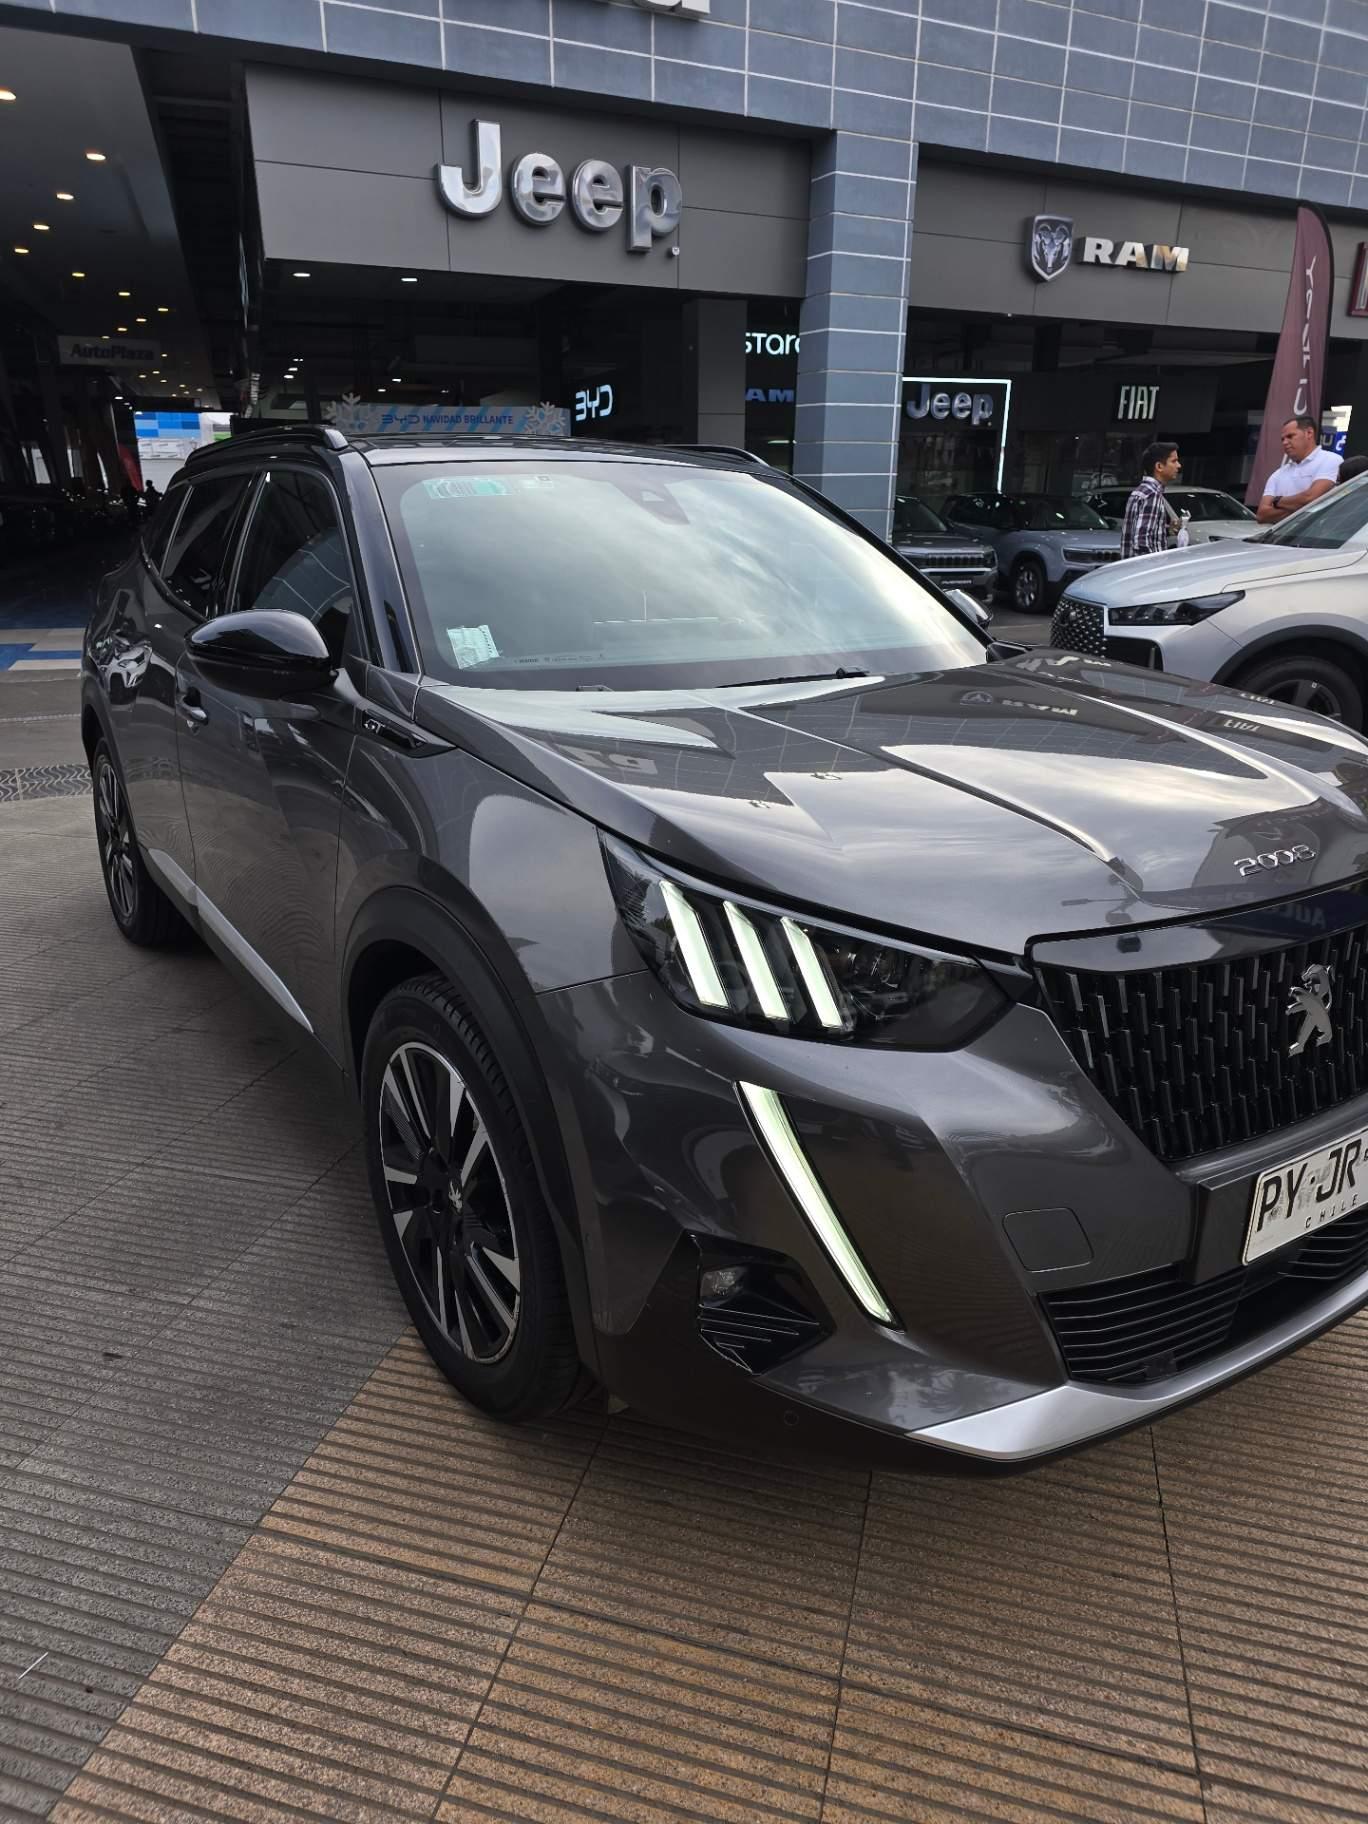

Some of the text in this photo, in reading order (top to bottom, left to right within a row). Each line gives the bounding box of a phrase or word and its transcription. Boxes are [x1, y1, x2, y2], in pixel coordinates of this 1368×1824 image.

[1080, 236, 1190, 272] RAM
[575, 384, 613, 422] BYD
[745, 388, 795, 403] AM
[906, 383, 994, 426] Jeep
[1117, 385, 1160, 420] FIAT
[423, 414, 461, 425] NAVIDAD
[464, 414, 513, 426] BRILLANTE
[1233, 844, 1316, 878] 2008
[1305, 1193, 1358, 1229] CHILE
